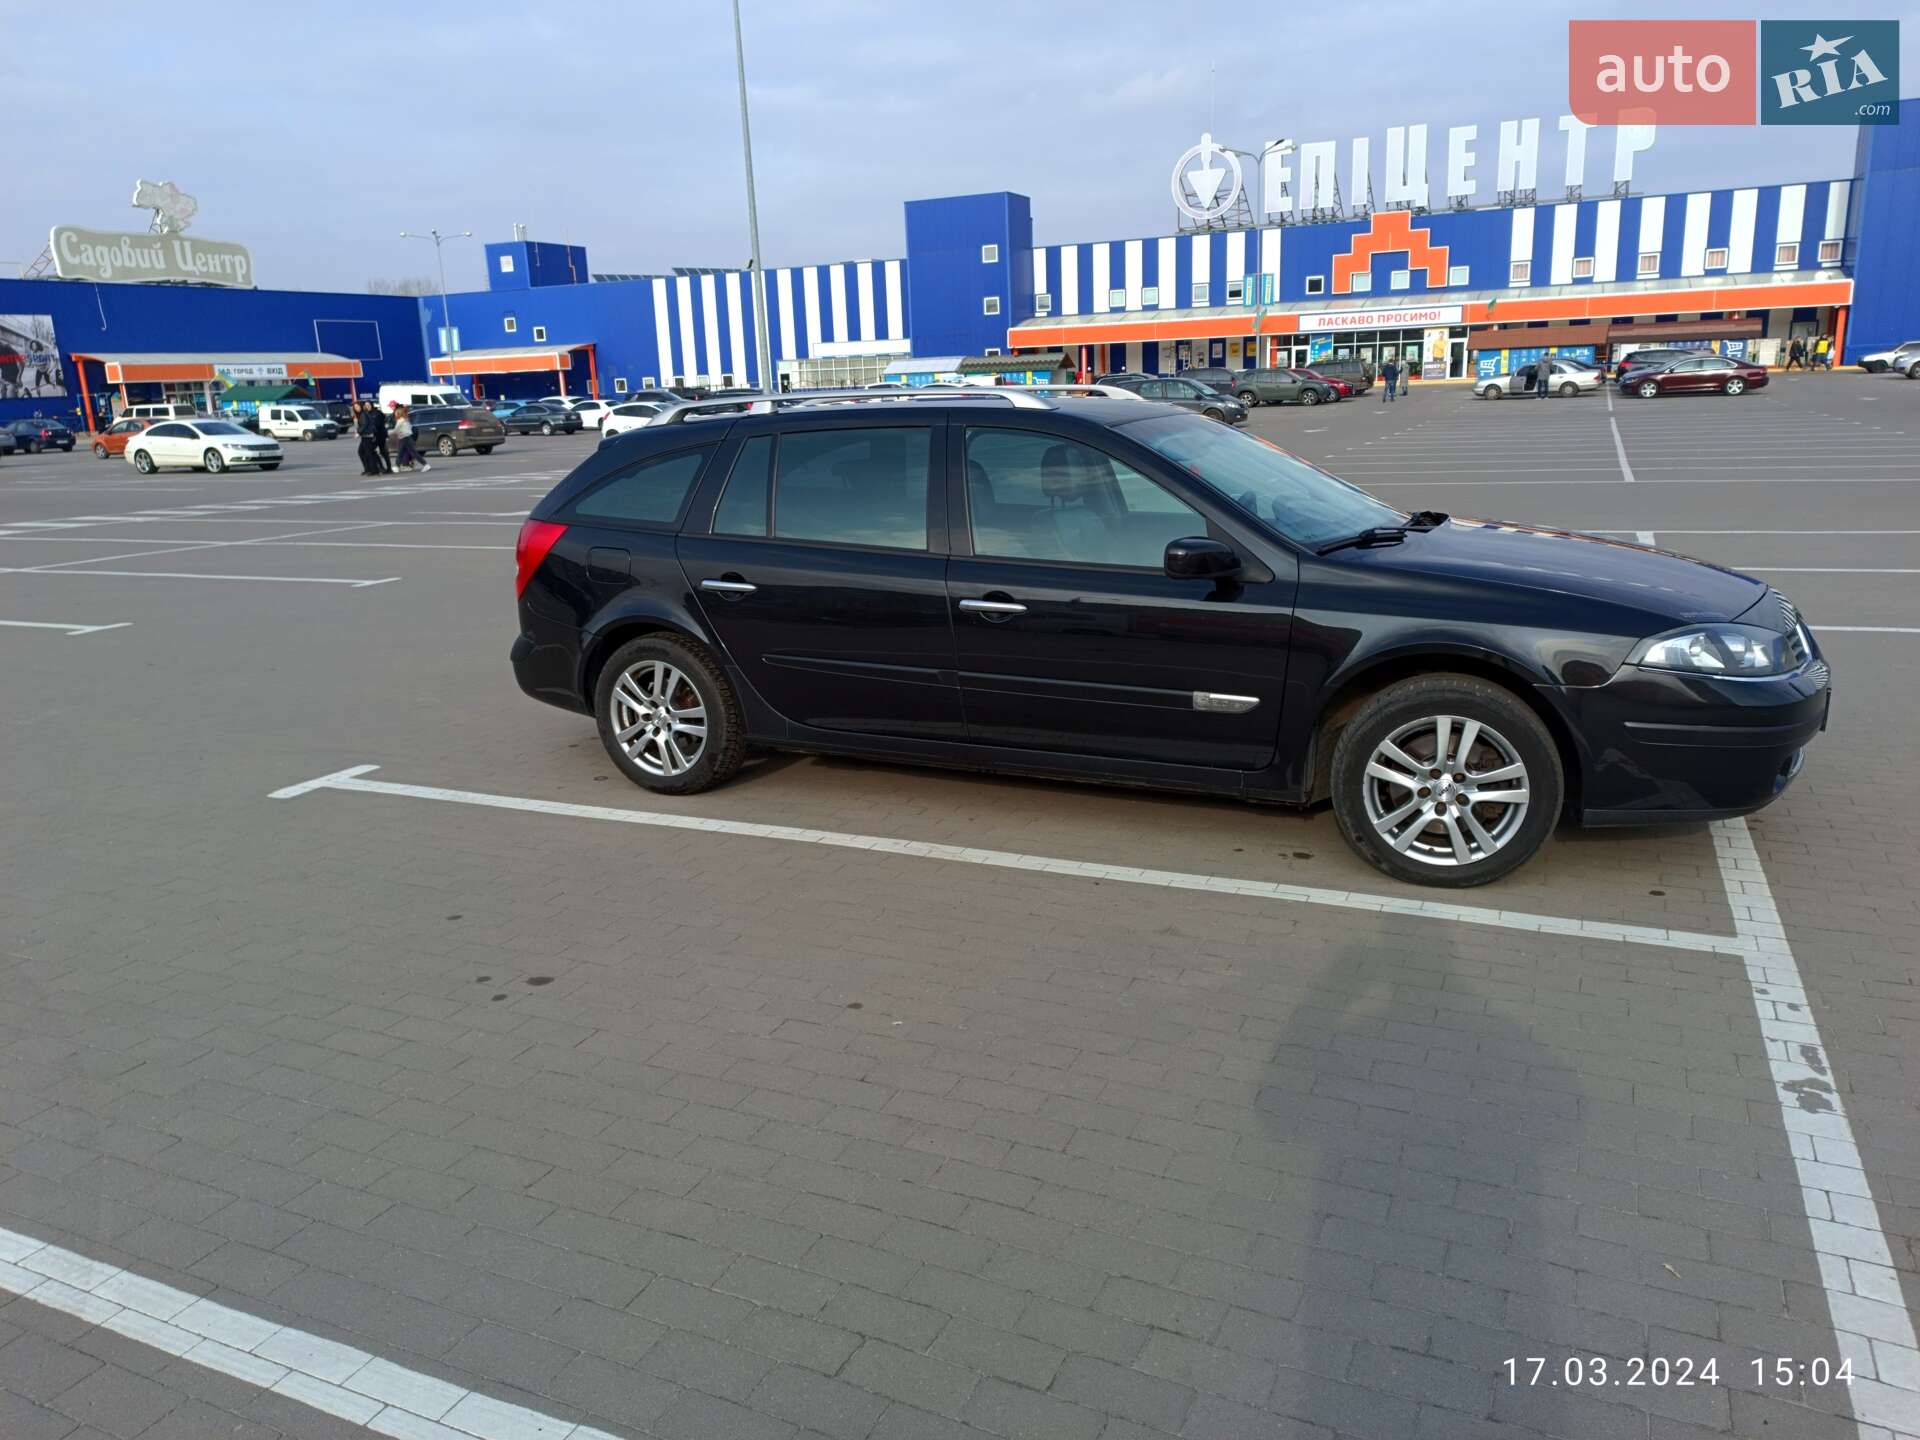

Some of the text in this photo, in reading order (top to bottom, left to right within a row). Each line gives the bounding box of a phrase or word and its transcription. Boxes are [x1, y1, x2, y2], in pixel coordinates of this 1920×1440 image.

[1264, 106, 1656, 214] ЕПІЦЕНТР
[60, 231, 247, 282] Садовий Центр
[1318, 311, 1441, 327] ЛАСКАВО ПРОСИМО!
